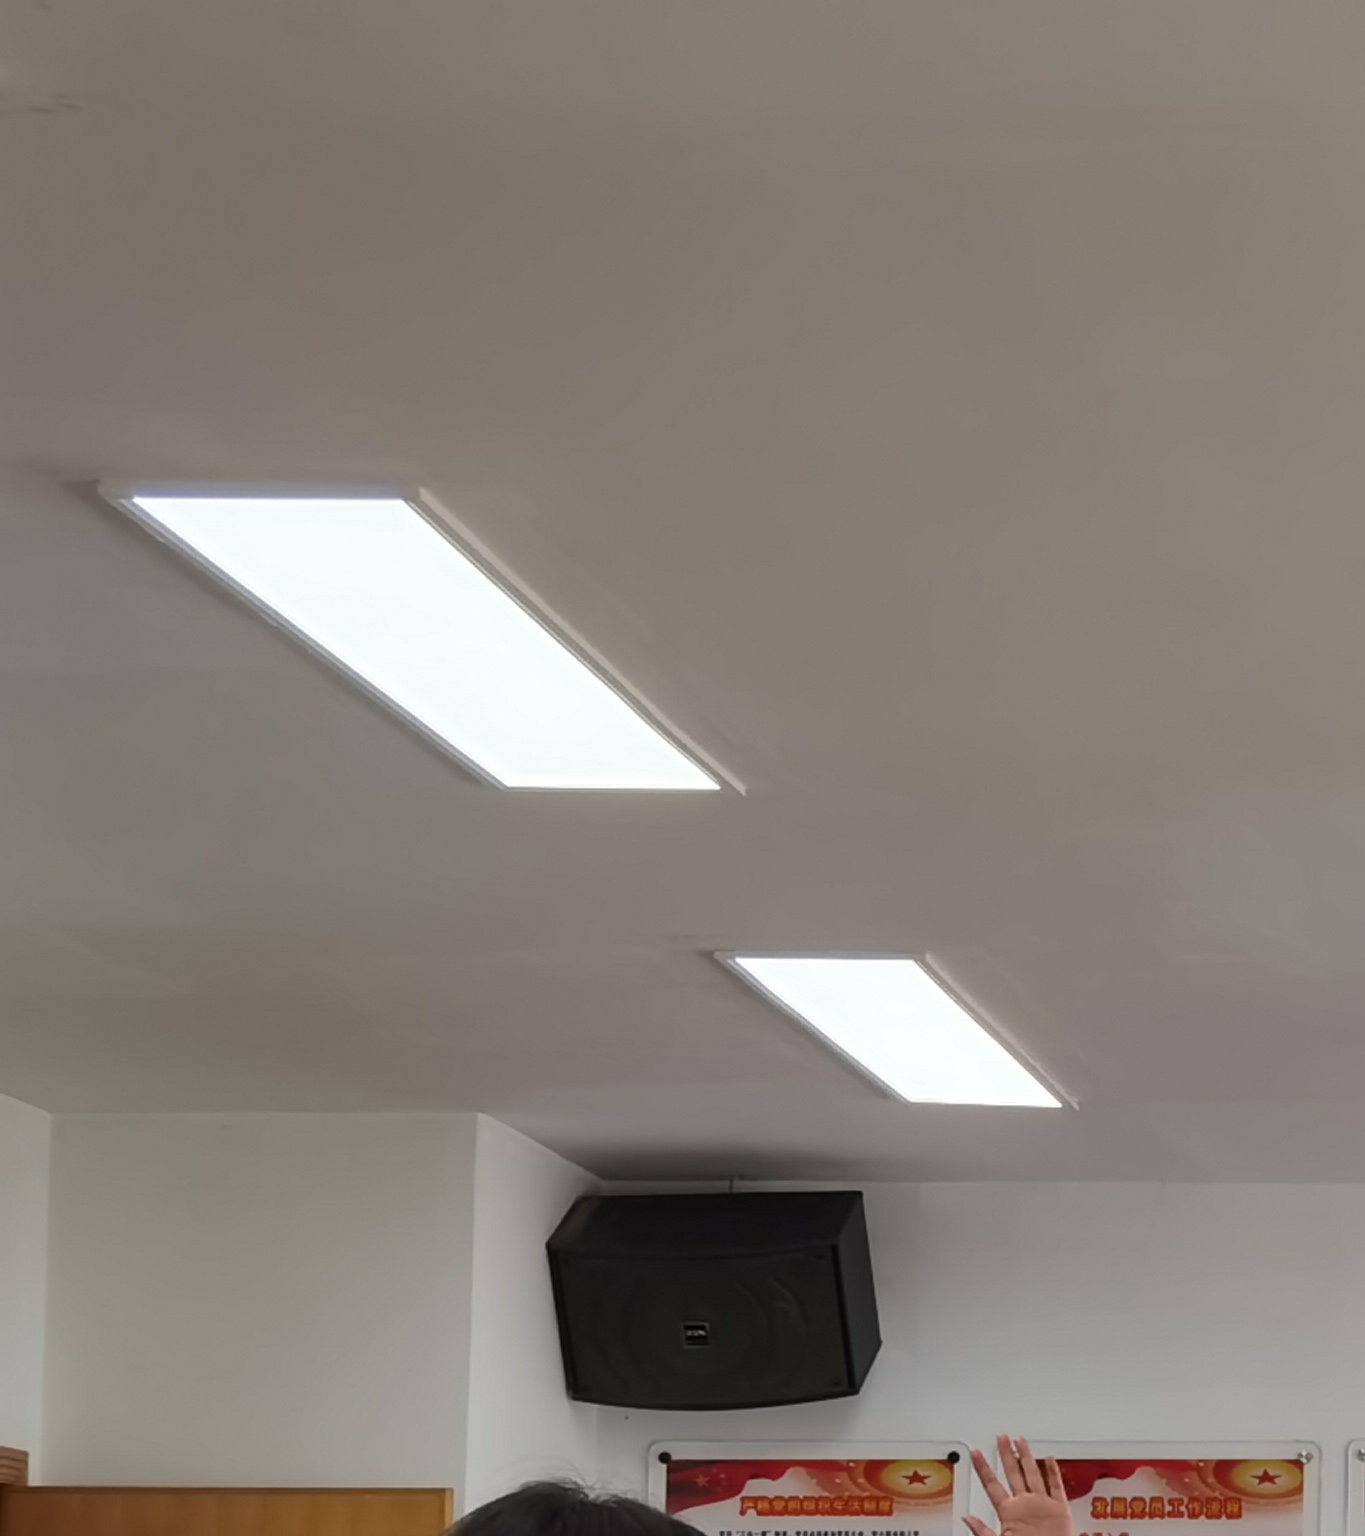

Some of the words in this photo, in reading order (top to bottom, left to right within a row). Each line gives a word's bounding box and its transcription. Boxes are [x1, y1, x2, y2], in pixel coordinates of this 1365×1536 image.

[1091, 1497, 1243, 1520] 发展党员工作流程
